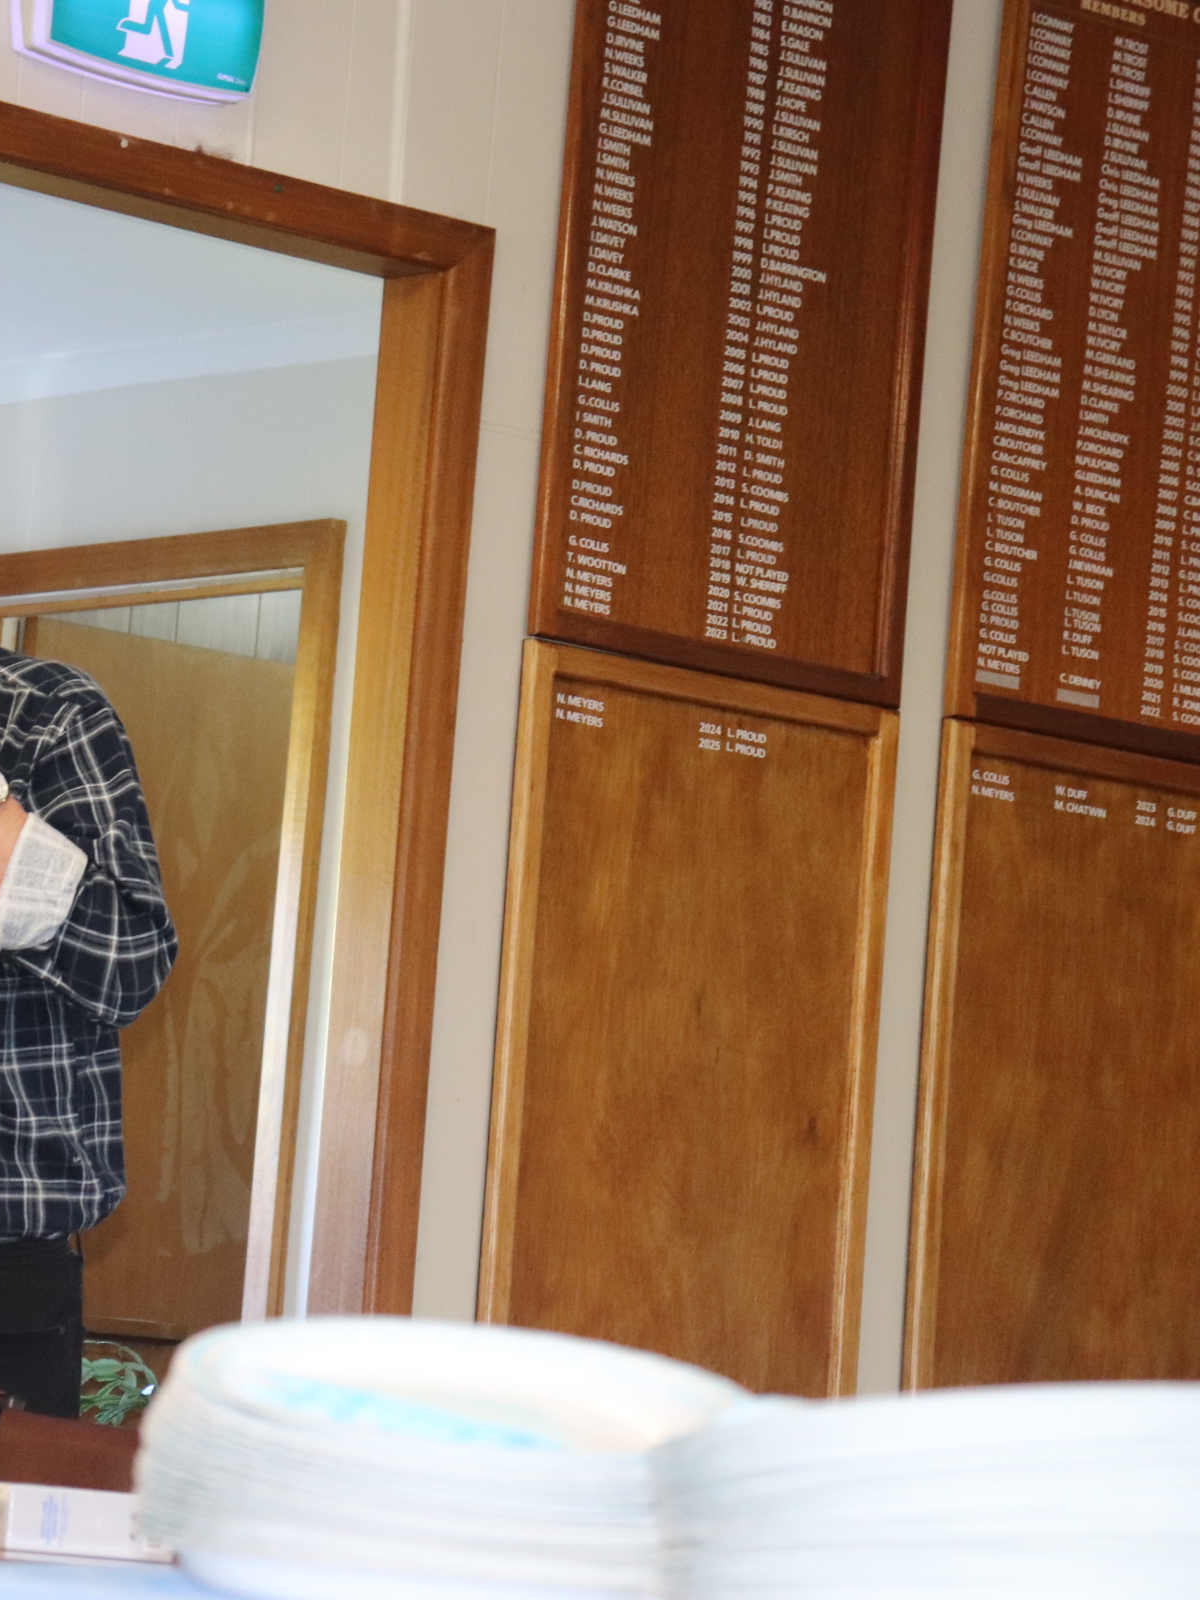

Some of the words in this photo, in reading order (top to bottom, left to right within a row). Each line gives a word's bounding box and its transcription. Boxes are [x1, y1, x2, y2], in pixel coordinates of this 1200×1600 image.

[736, 563, 755, 574] NOT
[755, 567, 789, 582] PLAYED
[978, 643, 997, 654] NOT
[998, 647, 1030, 662] PLAYED
[699, 722, 722, 735] 2024
[698, 737, 721, 751] 2025
